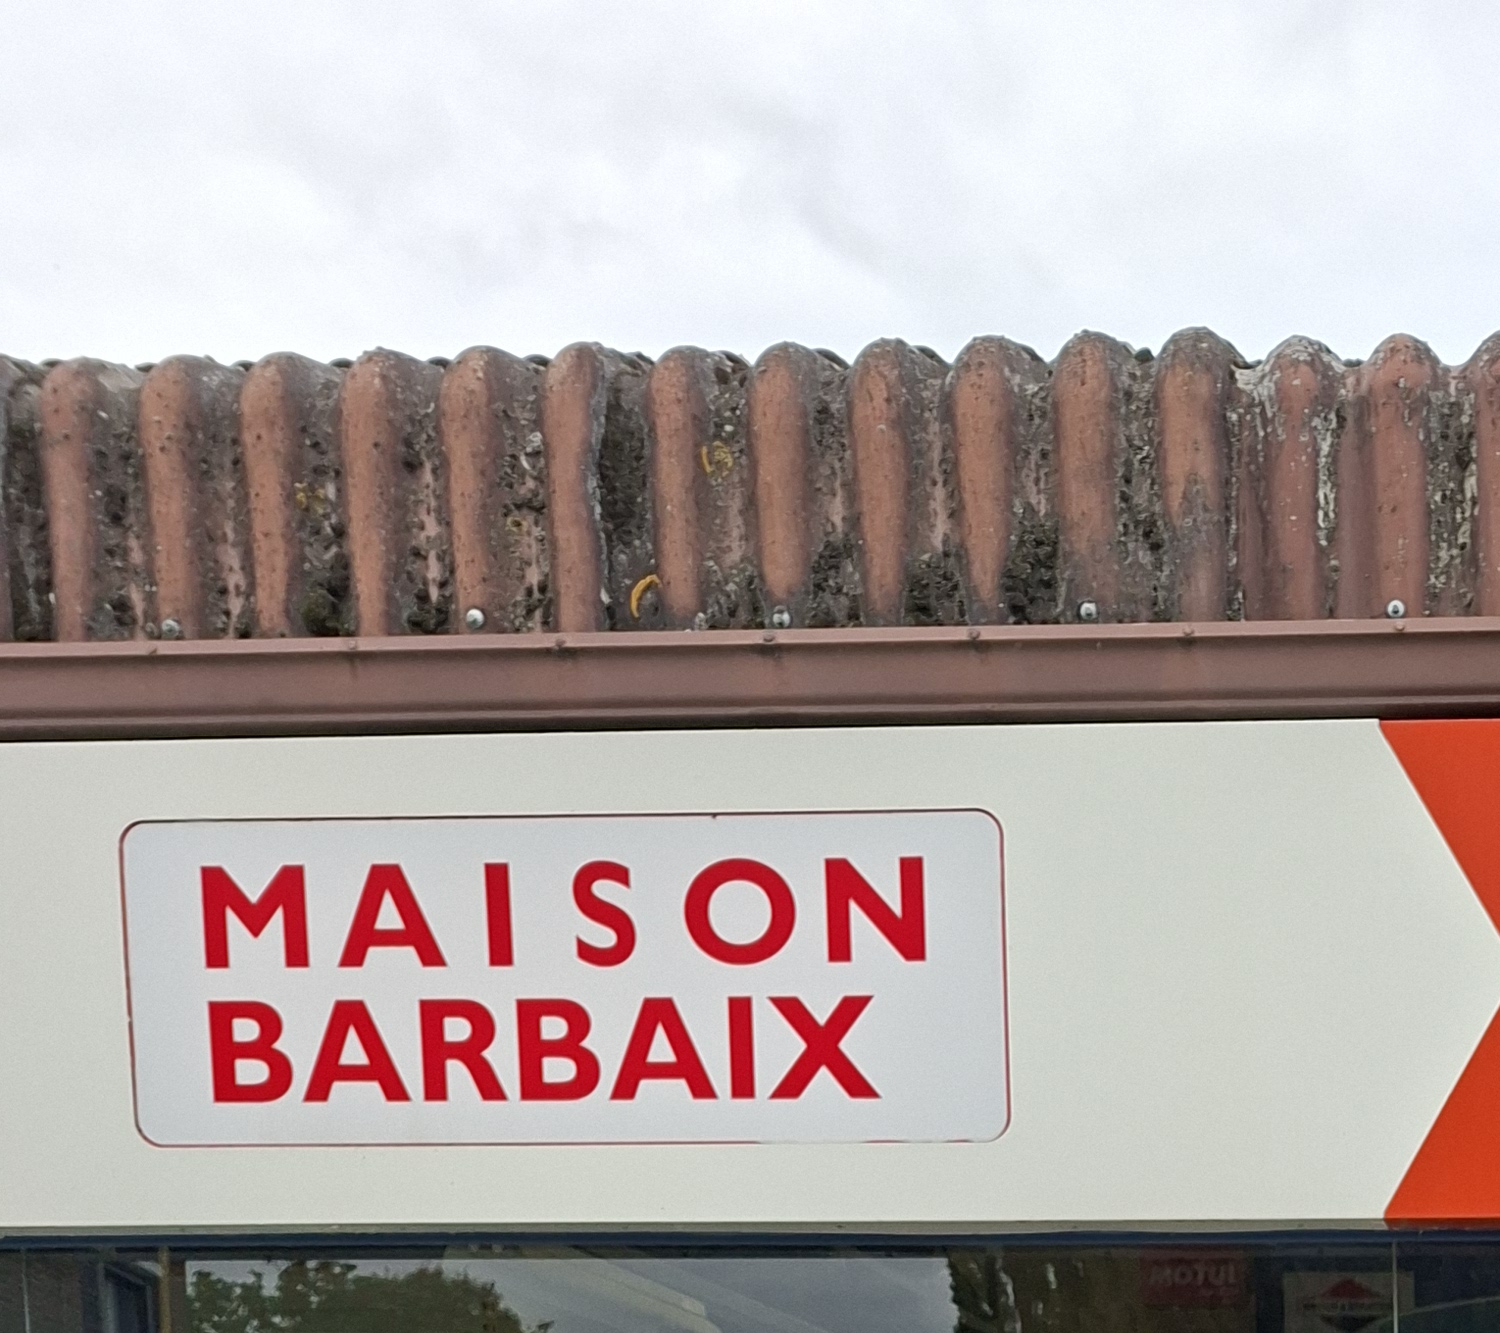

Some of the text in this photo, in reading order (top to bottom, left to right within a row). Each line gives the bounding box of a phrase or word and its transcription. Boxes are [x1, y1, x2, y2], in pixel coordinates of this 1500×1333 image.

[198, 856, 926, 970] MAISON
[206, 995, 880, 1104] BARBAIX
[1150, 1260, 1238, 1286] MOTUL
